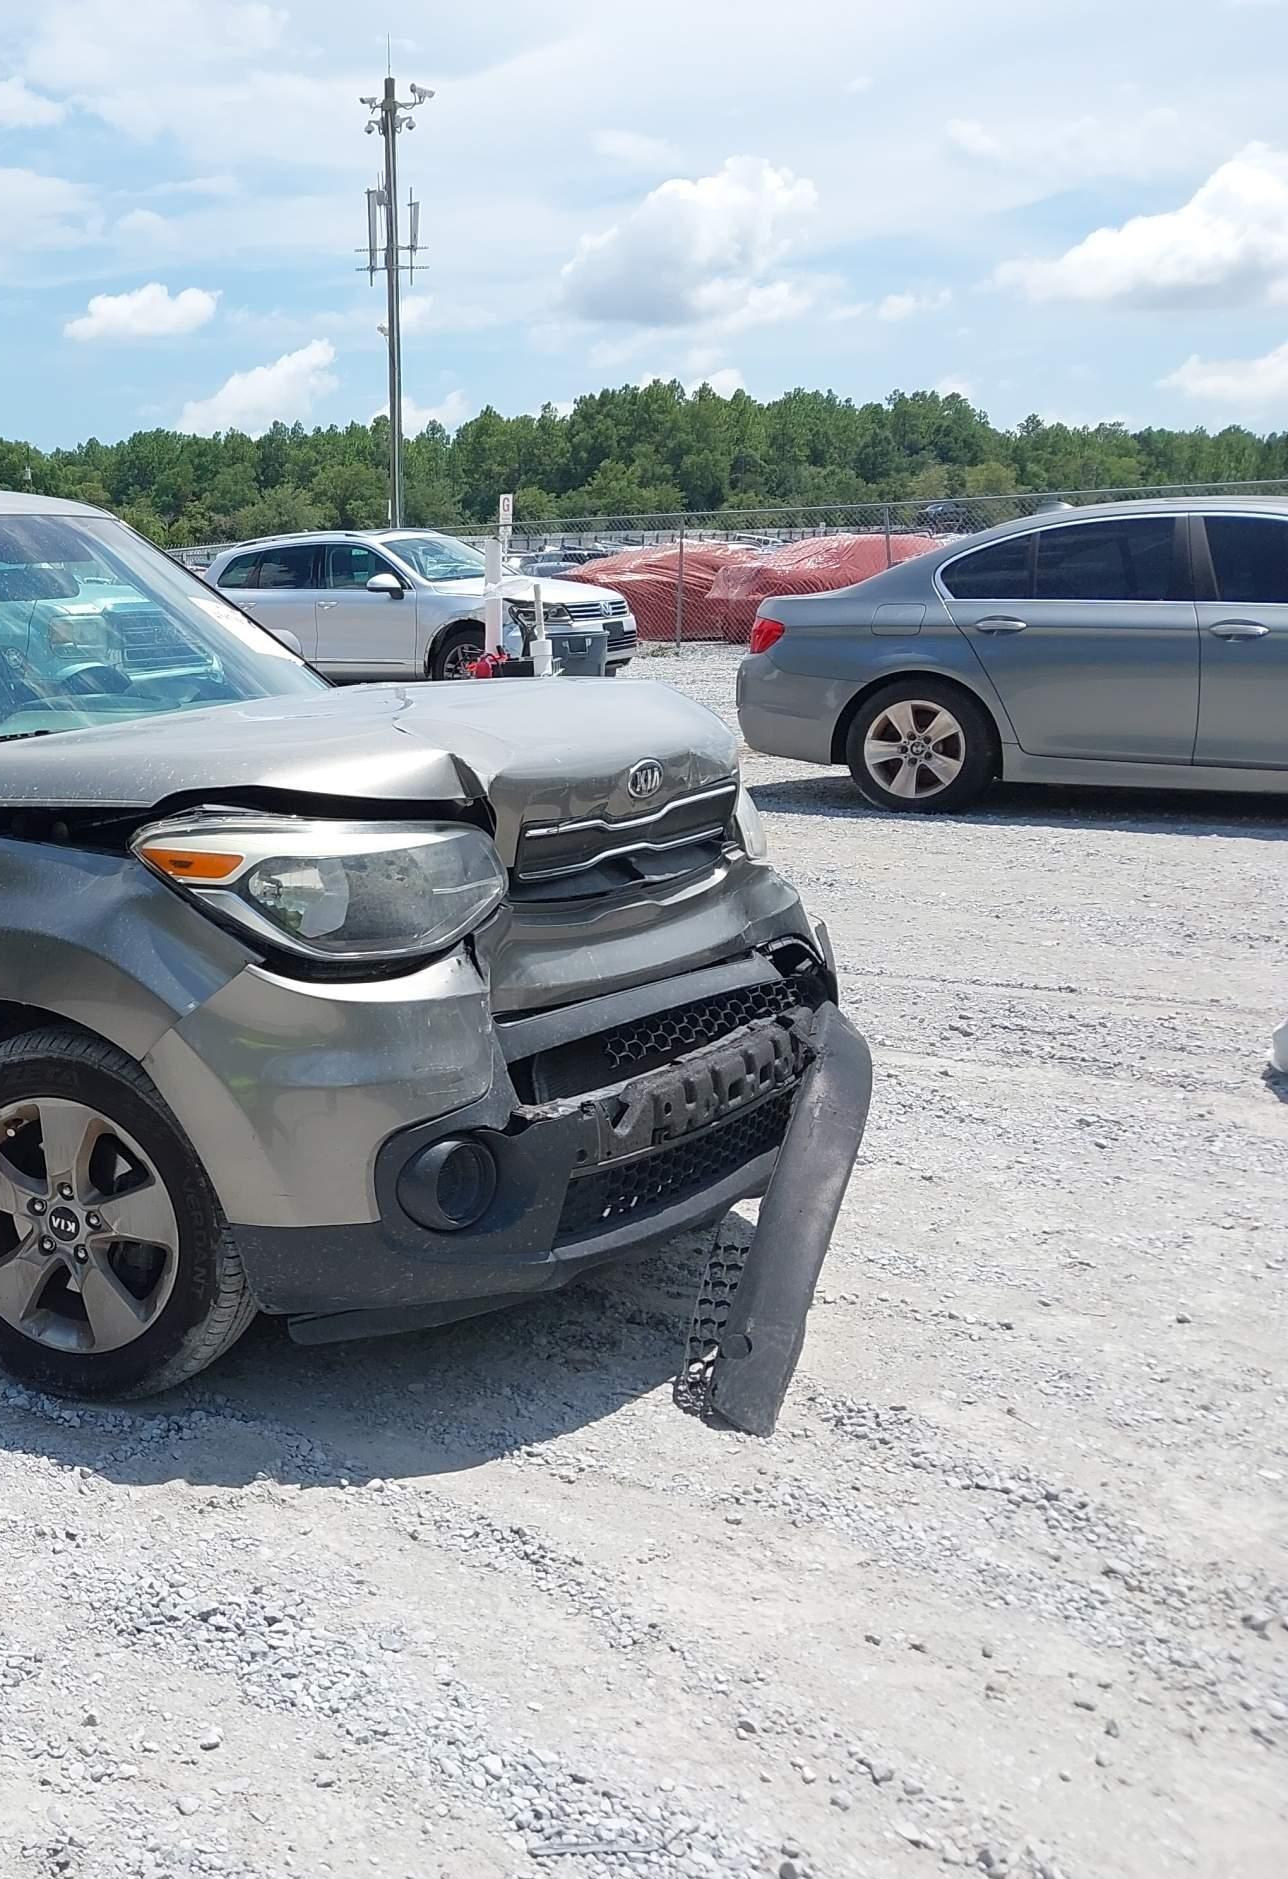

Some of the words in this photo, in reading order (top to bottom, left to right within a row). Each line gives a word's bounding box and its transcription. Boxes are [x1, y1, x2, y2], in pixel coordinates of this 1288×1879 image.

[502, 497, 510, 513] G
[635, 767, 660, 794] KIA
[51, 1215, 76, 1233] KIA
